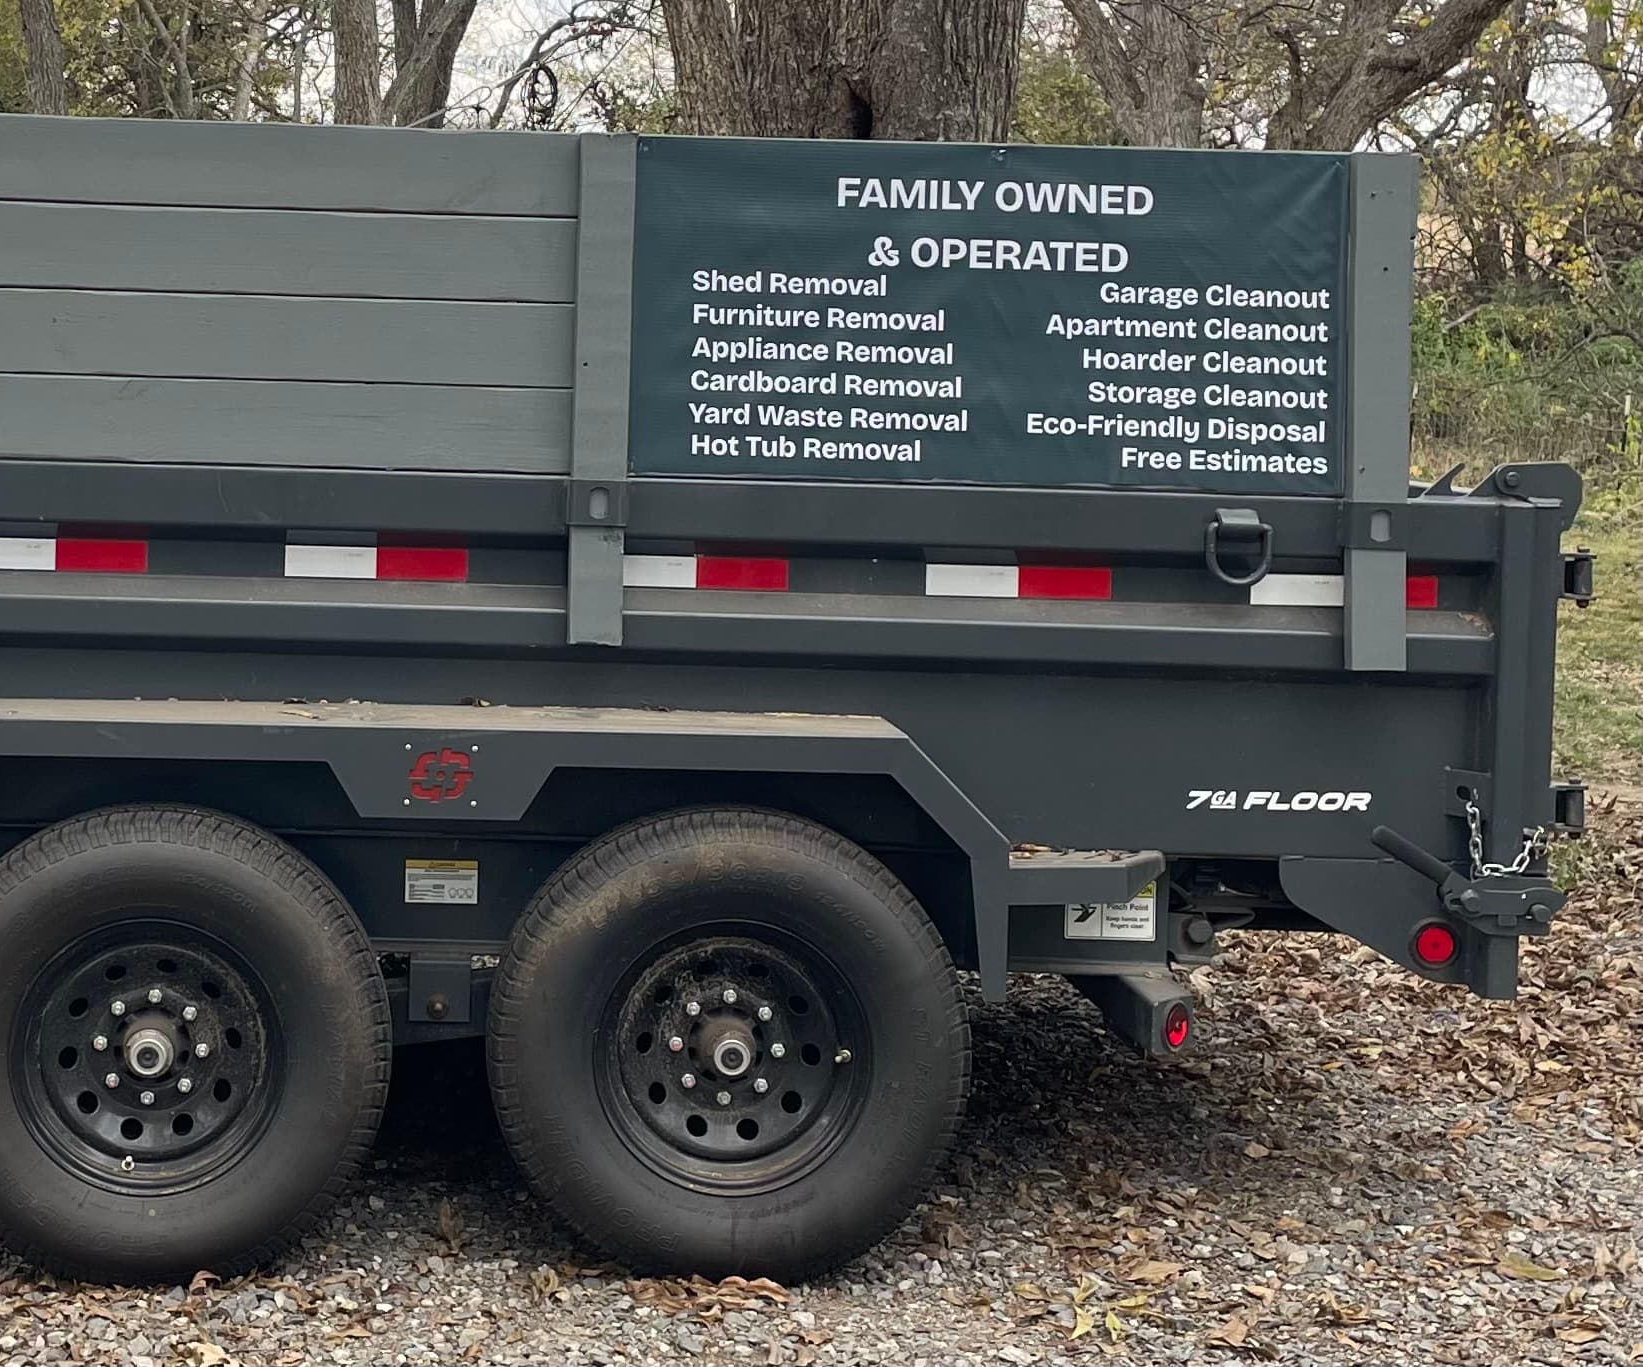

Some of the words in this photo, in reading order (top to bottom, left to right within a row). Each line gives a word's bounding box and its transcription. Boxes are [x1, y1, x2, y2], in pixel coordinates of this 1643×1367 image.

[837, 177, 985, 211] FAMILY
[995, 181, 1154, 216] OWNED
[867, 236, 900, 267] &
[910, 237, 1129, 273] OPERATED
[692, 269, 762, 293] Shed
[769, 272, 887, 297] Removal
[1100, 282, 1199, 310] Garage
[1205, 283, 1330, 310] Cleanout
[693, 303, 820, 328] Furniture
[827, 307, 945, 332] Removal
[1045, 314, 1197, 340] Apartment
[1203, 317, 1329, 343] Cleanout
[691, 336, 829, 363] Appliance
[836, 340, 953, 365] Removal
[1082, 348, 1197, 372] Hoarder
[1202, 350, 1327, 376] Cleanout
[690, 369, 837, 395] Cardboard
[844, 374, 962, 399] Removal
[1088, 381, 1197, 410] Storage
[1203, 383, 1329, 410] Cleanout
[688, 402, 751, 425] Yard
[757, 404, 843, 428] Waste
[850, 407, 968, 432] Removal
[1026, 412, 1200, 444] Eco-Friendly
[1207, 416, 1326, 445] Disposal
[691, 434, 740, 457] Hot
[744, 435, 797, 458] Tub
[803, 437, 921, 462] Removal
[1121, 447, 1182, 470] Free
[1189, 449, 1328, 475] Estimates
[1242, 791, 1372, 812] FLOOR
